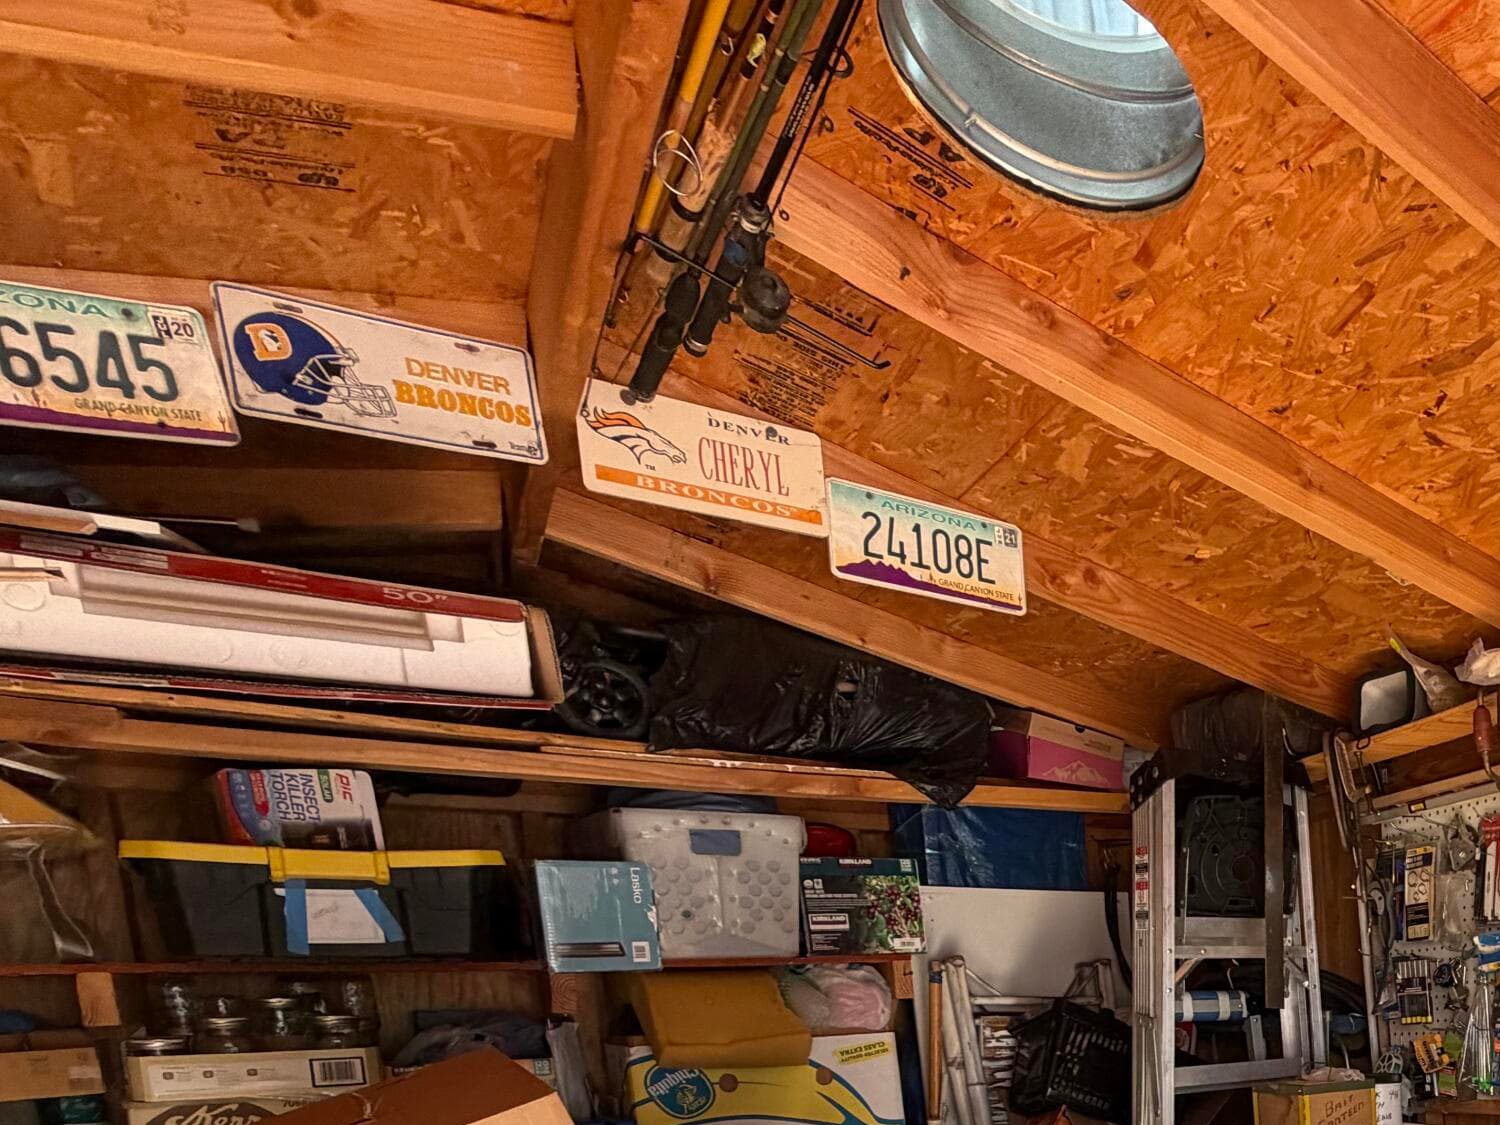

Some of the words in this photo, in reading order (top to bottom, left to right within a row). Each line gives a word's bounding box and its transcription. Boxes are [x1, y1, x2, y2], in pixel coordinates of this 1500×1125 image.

[0, 289, 114, 319] ONA
[172, 321, 195, 339] 20
[404, 356, 512, 396] DENVER
[392, 378, 532, 428] BRONCOS
[698, 436, 790, 497] CHERYL
[635, 474, 794, 518] BRONCOS
[880, 499, 977, 533] ARIZONA
[861, 511, 996, 585] 24108E
[381, 586, 449, 606] 50"
[938, 578, 964, 593] GRAND
[964, 584, 995, 598] CANYON
[995, 590, 1015, 601] STATE
[269, 772, 292, 822] TORCH
[284, 772, 306, 823] KILLER
[299, 772, 322, 824] INSECT
[629, 866, 642, 905] Lasko
[838, 1043, 862, 1058] EXTRA
[861, 1040, 886, 1051] CLASS
